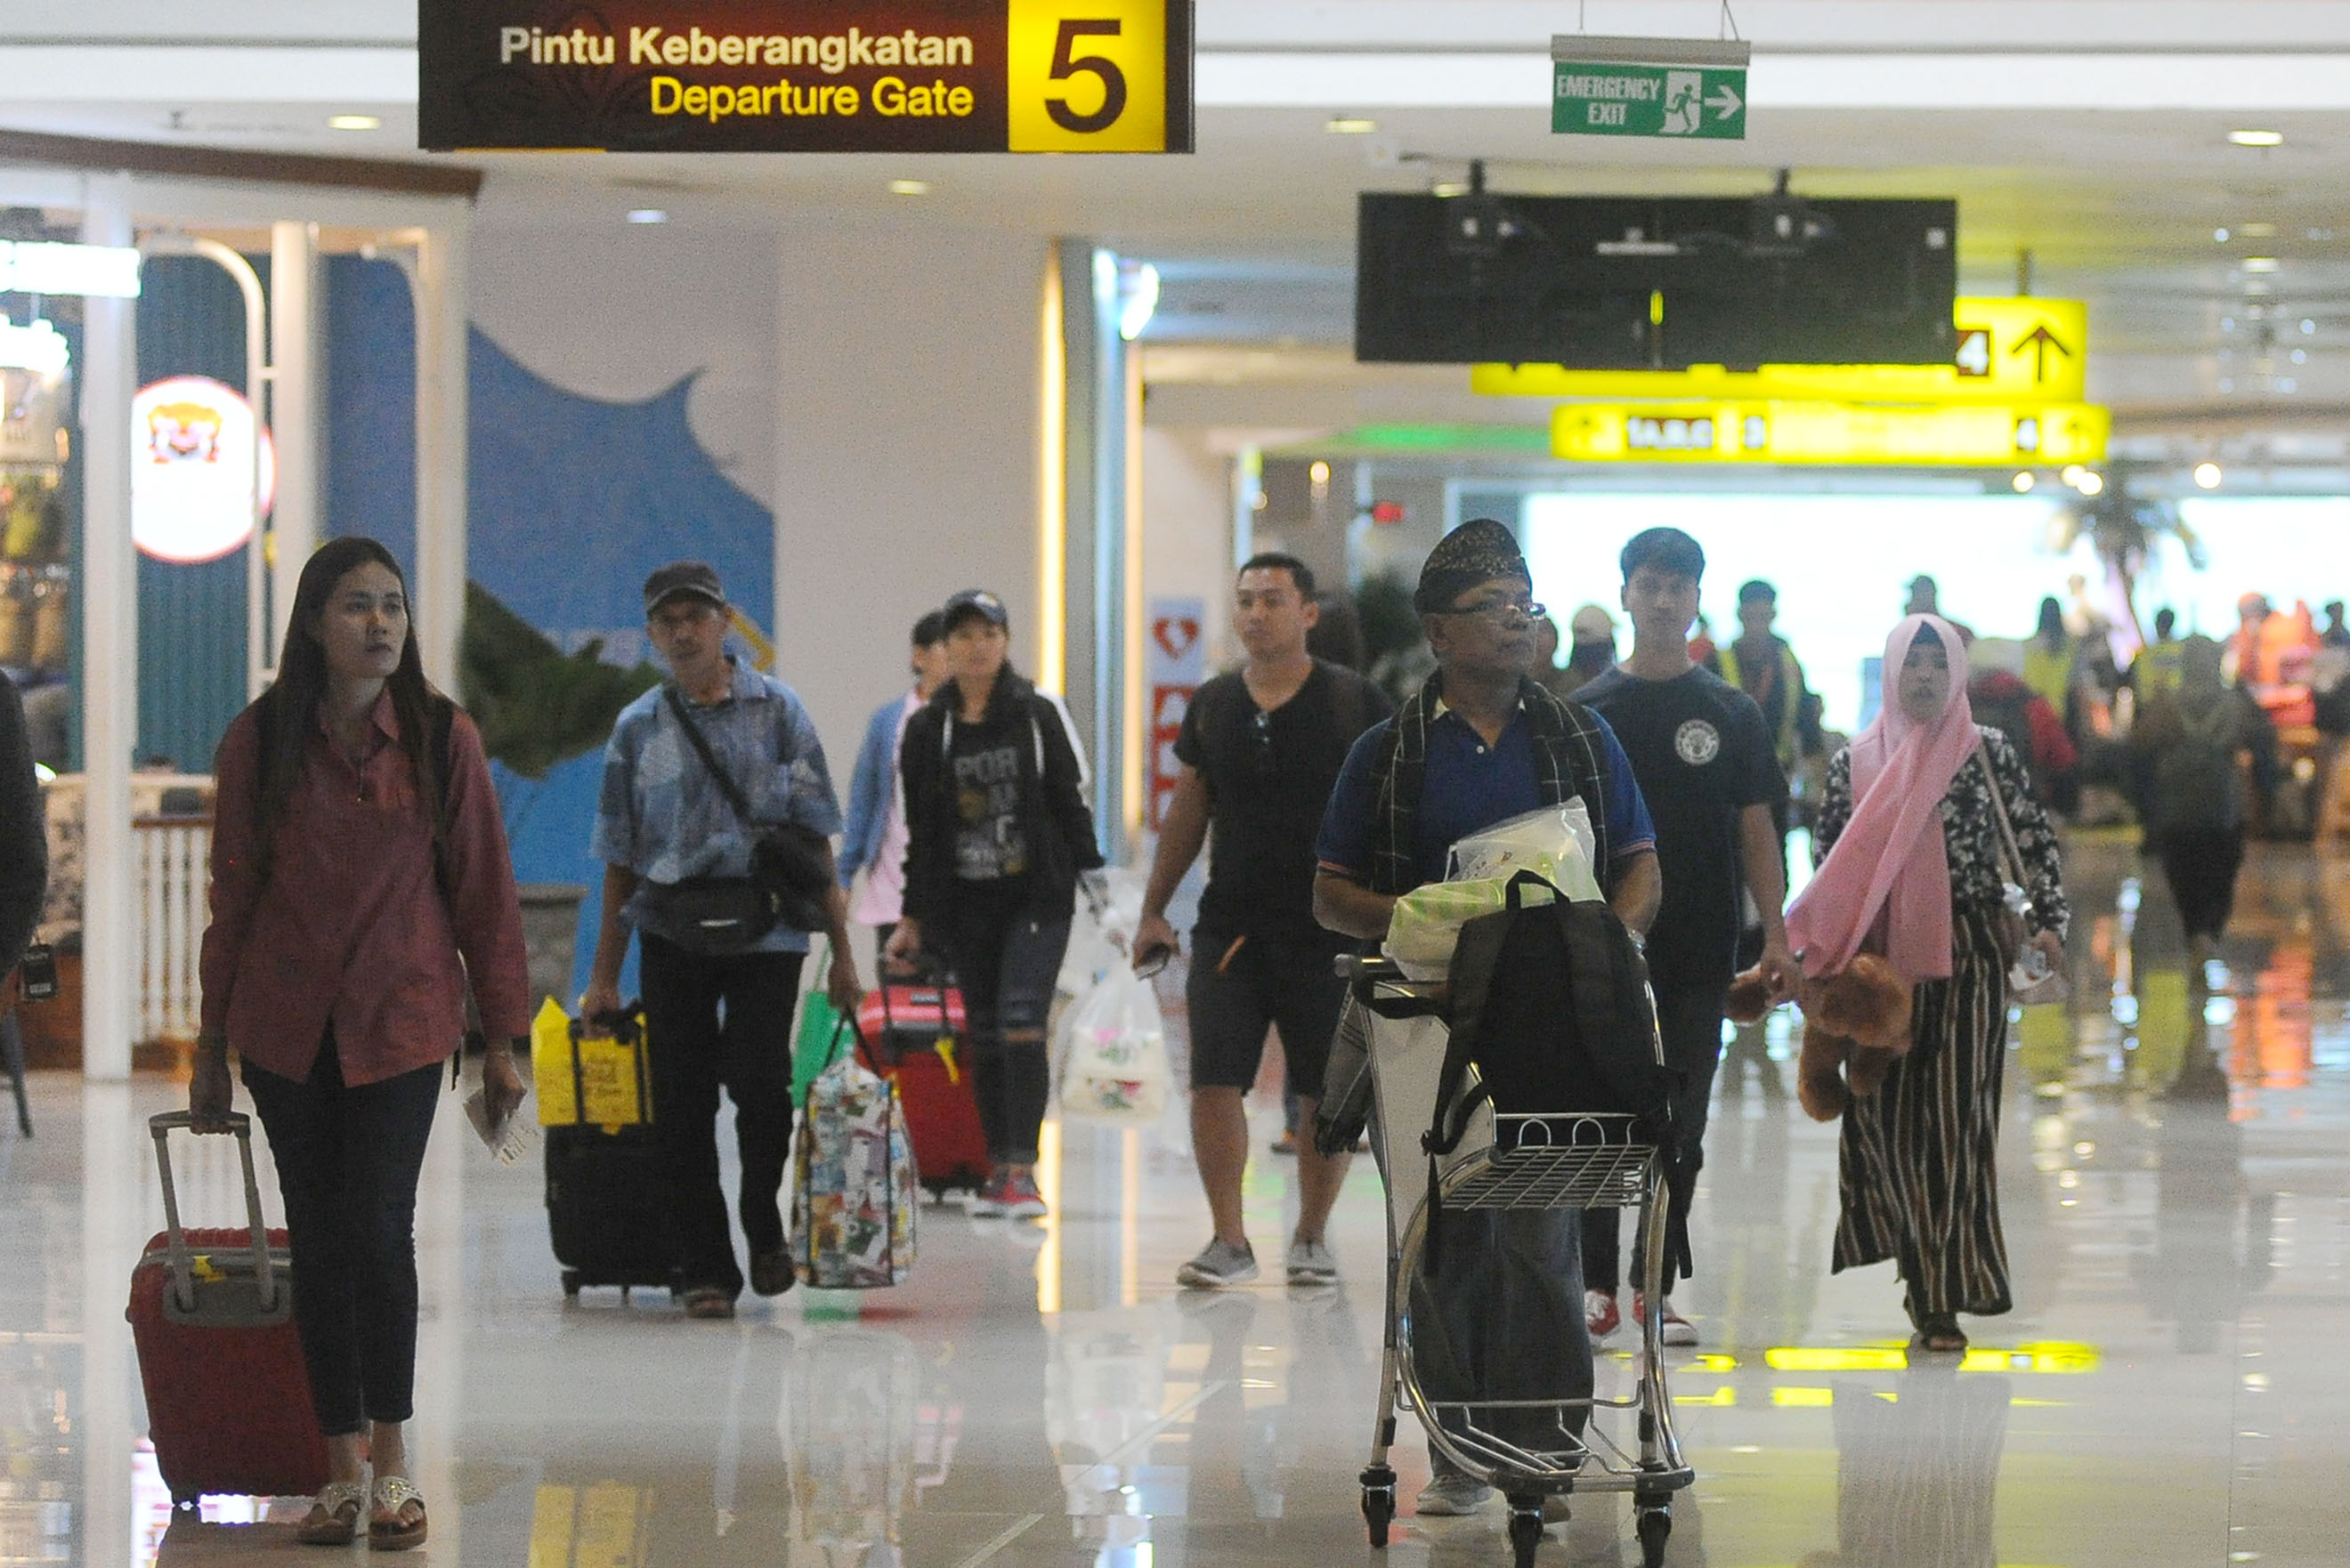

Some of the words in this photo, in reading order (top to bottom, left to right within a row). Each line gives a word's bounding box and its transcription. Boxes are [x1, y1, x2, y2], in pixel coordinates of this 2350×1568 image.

[502, 28, 615, 63] Pintu
[628, 27, 974, 74] Keberangkatan
[651, 77, 862, 122] Departure
[872, 76, 975, 117] Gate
[1047, 20, 1127, 133] 5
[1557, 75, 1661, 101] EMERGENCY
[1589, 102, 1627, 125] EXIT
[1956, 332, 1989, 376] 4
